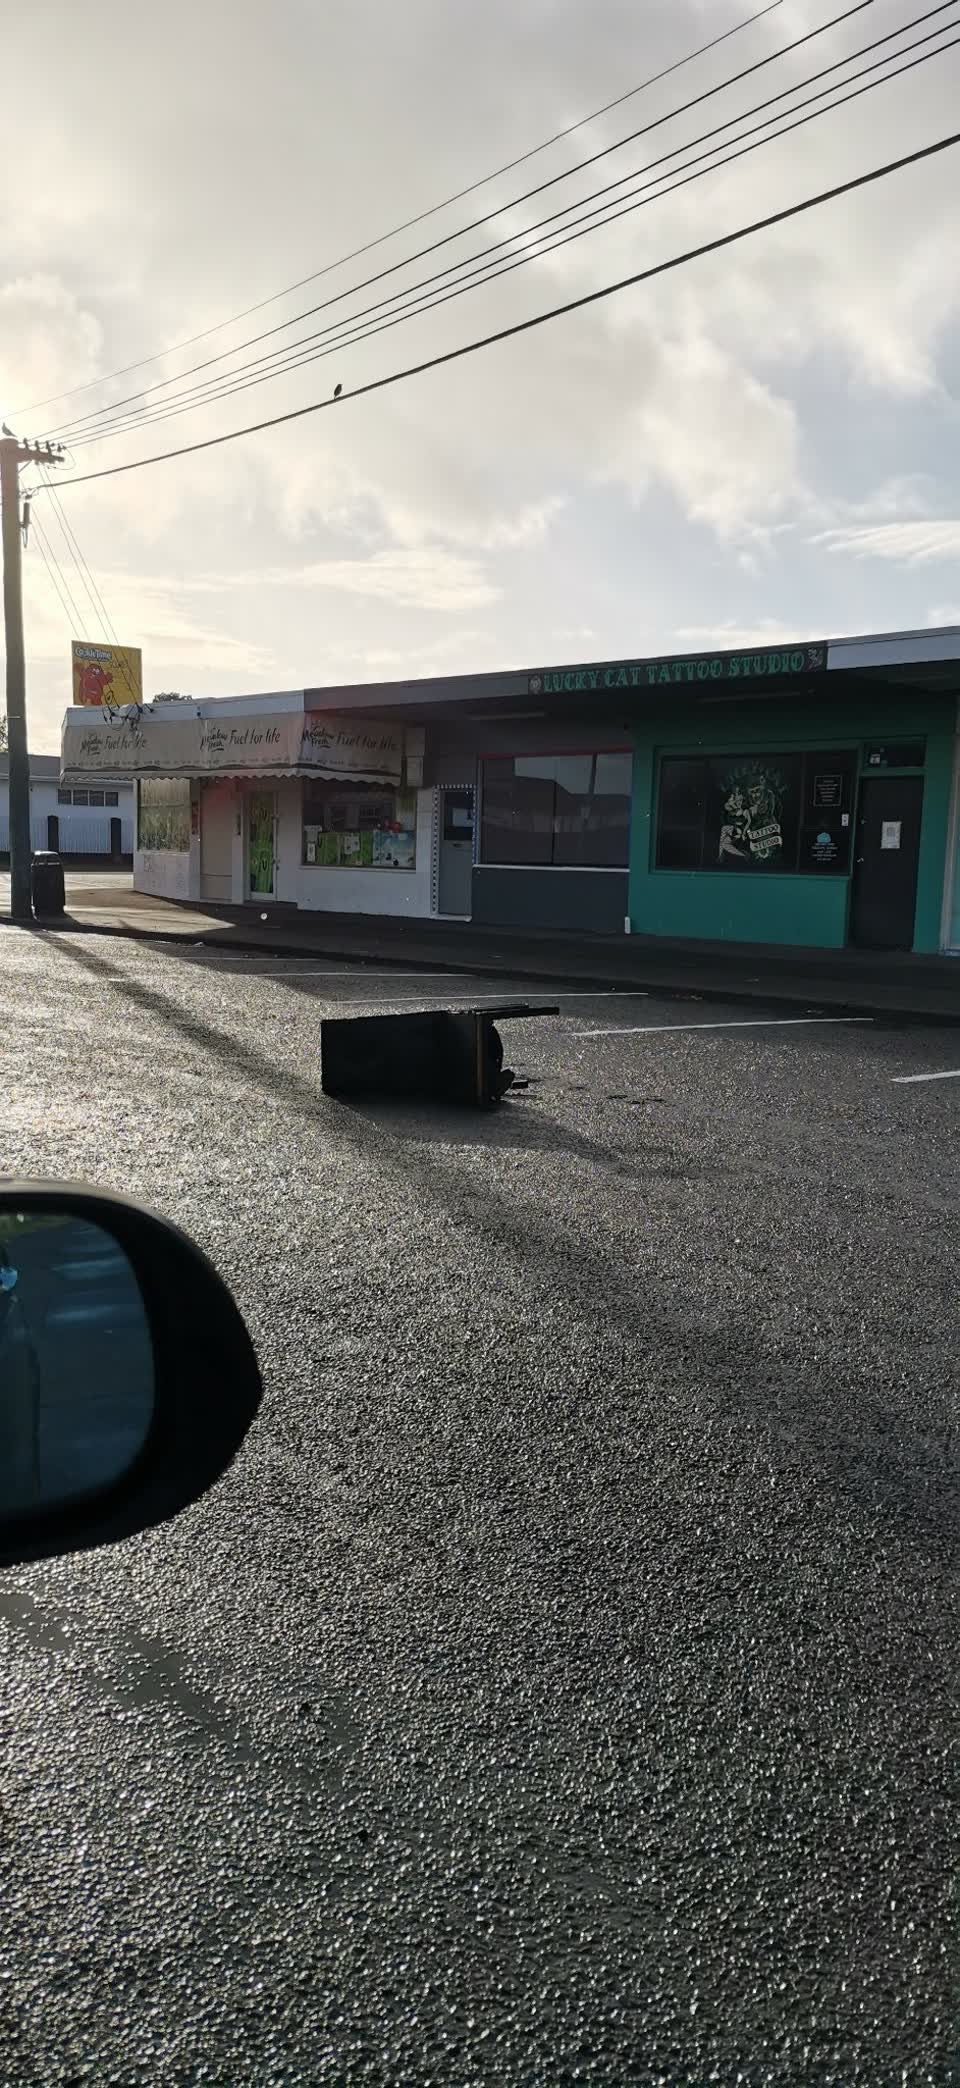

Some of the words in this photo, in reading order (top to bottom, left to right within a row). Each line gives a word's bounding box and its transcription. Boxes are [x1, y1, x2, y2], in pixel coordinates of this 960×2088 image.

[543, 669, 599, 693] LUCKY
[604, 666, 641, 688] CAT
[646, 658, 722, 685] TATTOO
[728, 650, 805, 677] STUDIO
[104, 735, 120, 750] Fuel
[229, 729, 249, 745] Fuel
[249, 728, 264, 745] for
[264, 727, 281, 744] life
[336, 730, 361, 746] Fuel
[361, 736, 378, 750] for
[750, 824, 780, 838] TATTOO
[752, 837, 780, 850] STUDIO
